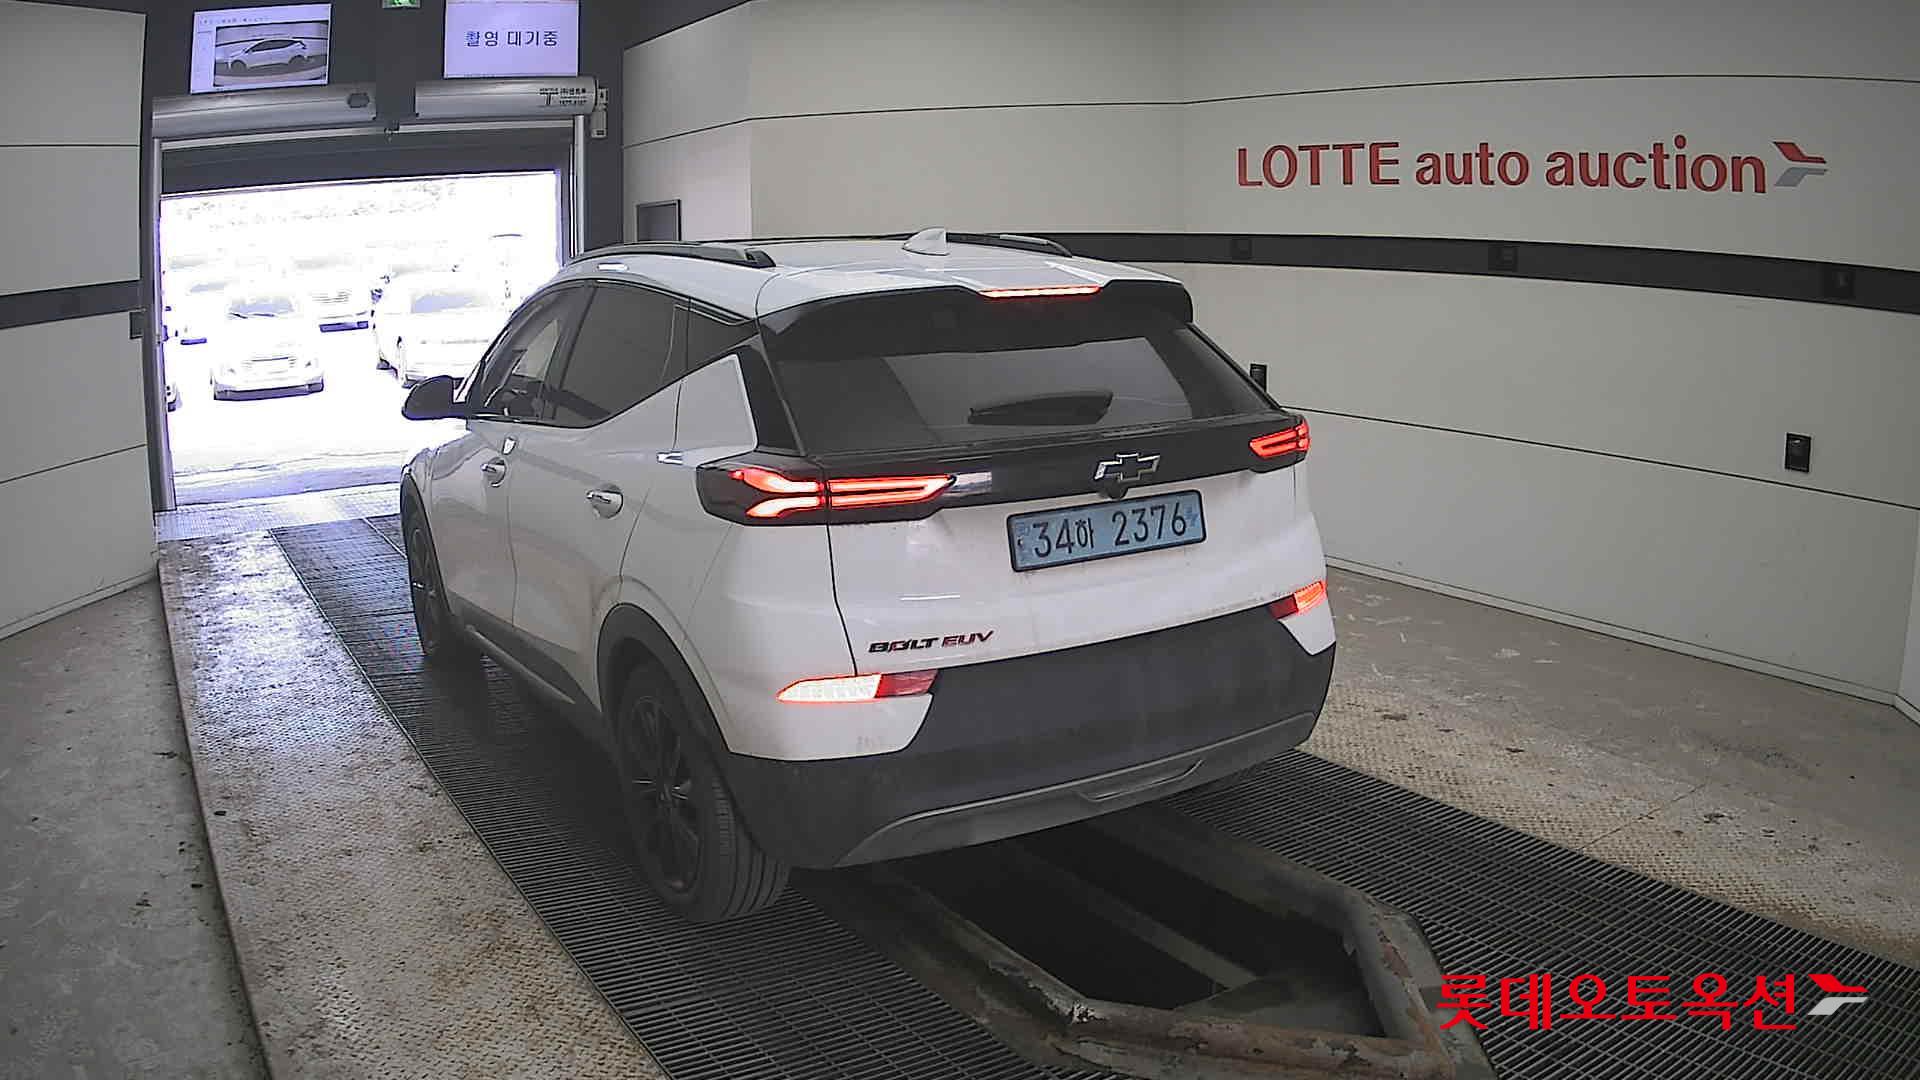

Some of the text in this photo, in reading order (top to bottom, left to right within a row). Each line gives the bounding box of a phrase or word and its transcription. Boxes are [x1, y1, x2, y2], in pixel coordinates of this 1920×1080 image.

[507, 31, 558, 47] 대기중
[1238, 135, 1767, 193] LOTTE auto auction
[1032, 502, 1187, 558] 34하 2376
[868, 630, 994, 653] BOLT EUV
